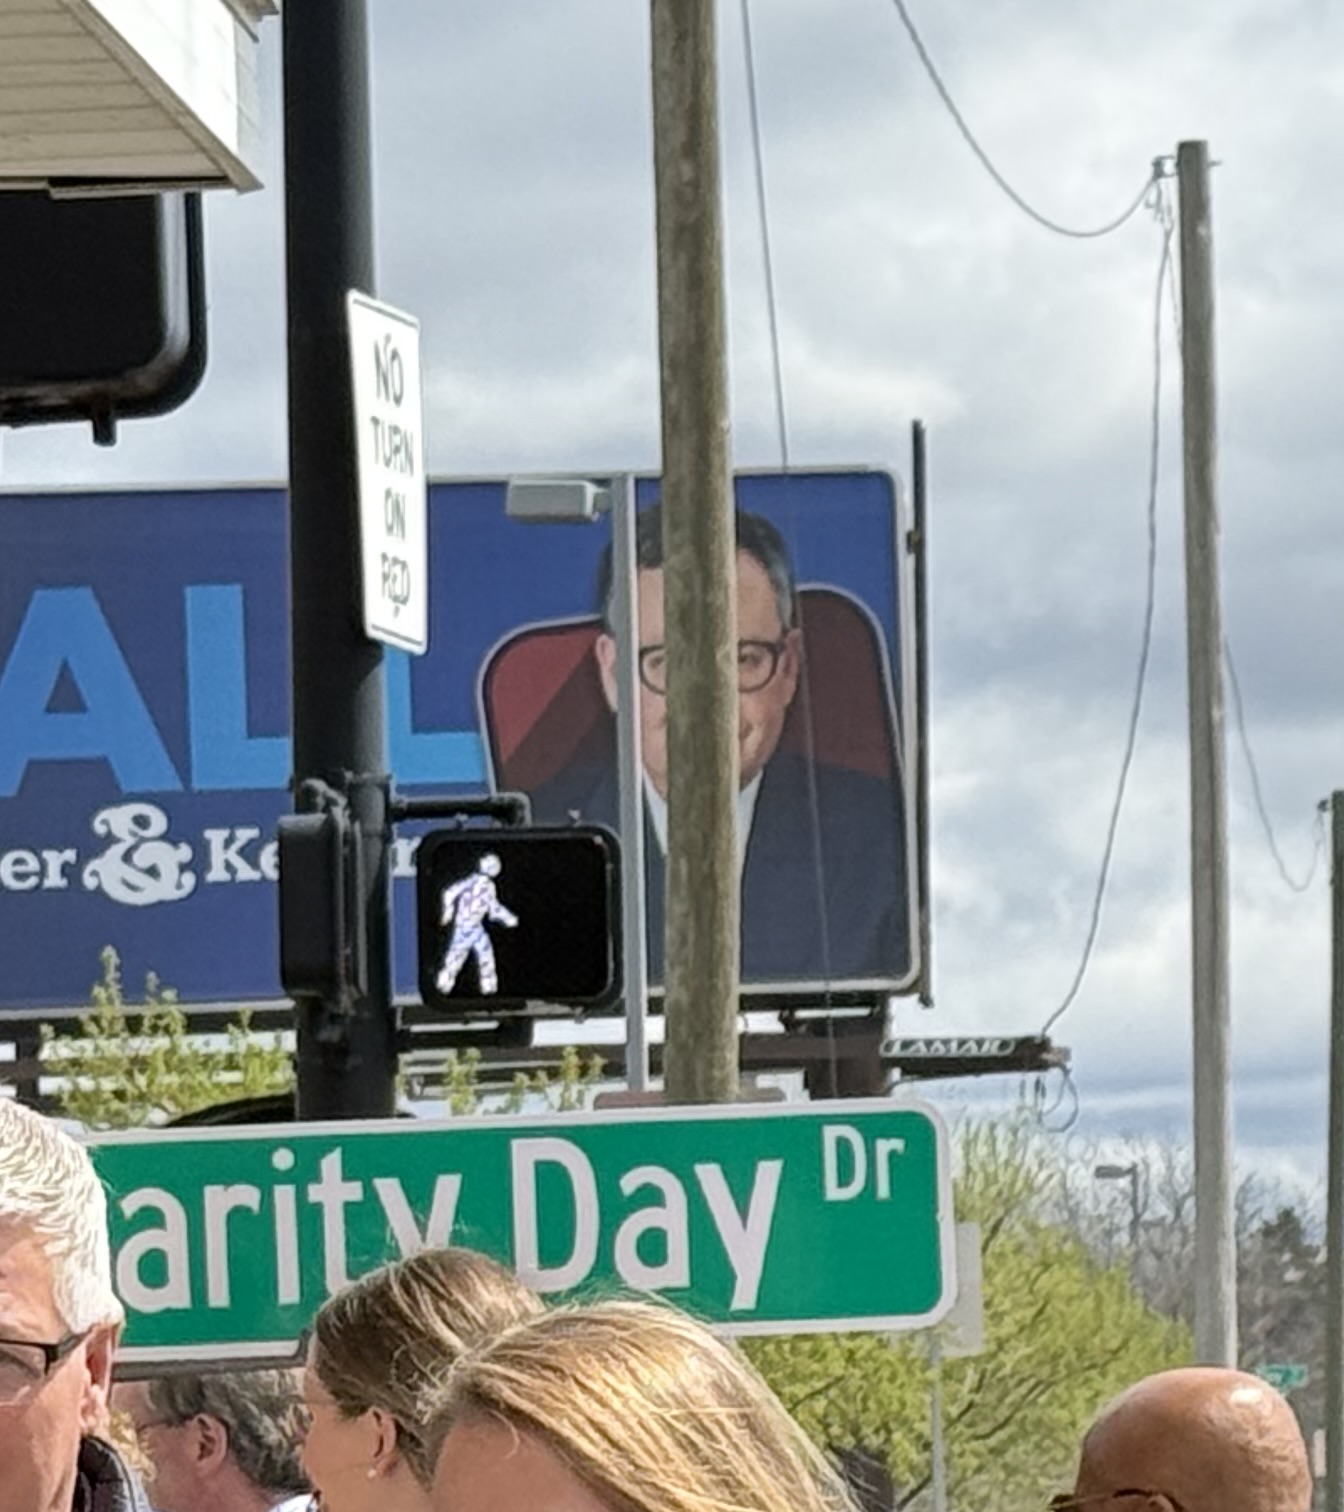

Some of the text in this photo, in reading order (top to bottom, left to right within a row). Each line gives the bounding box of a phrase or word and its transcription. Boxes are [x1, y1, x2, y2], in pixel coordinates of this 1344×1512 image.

[373, 332, 405, 408] NO
[369, 415, 416, 478] TURN
[383, 487, 407, 541] ON
[380, 552, 412, 608] RED
[81, 803, 196, 906] &
[510, 1136, 785, 1312] Day
[821, 1123, 906, 1202] Dr
